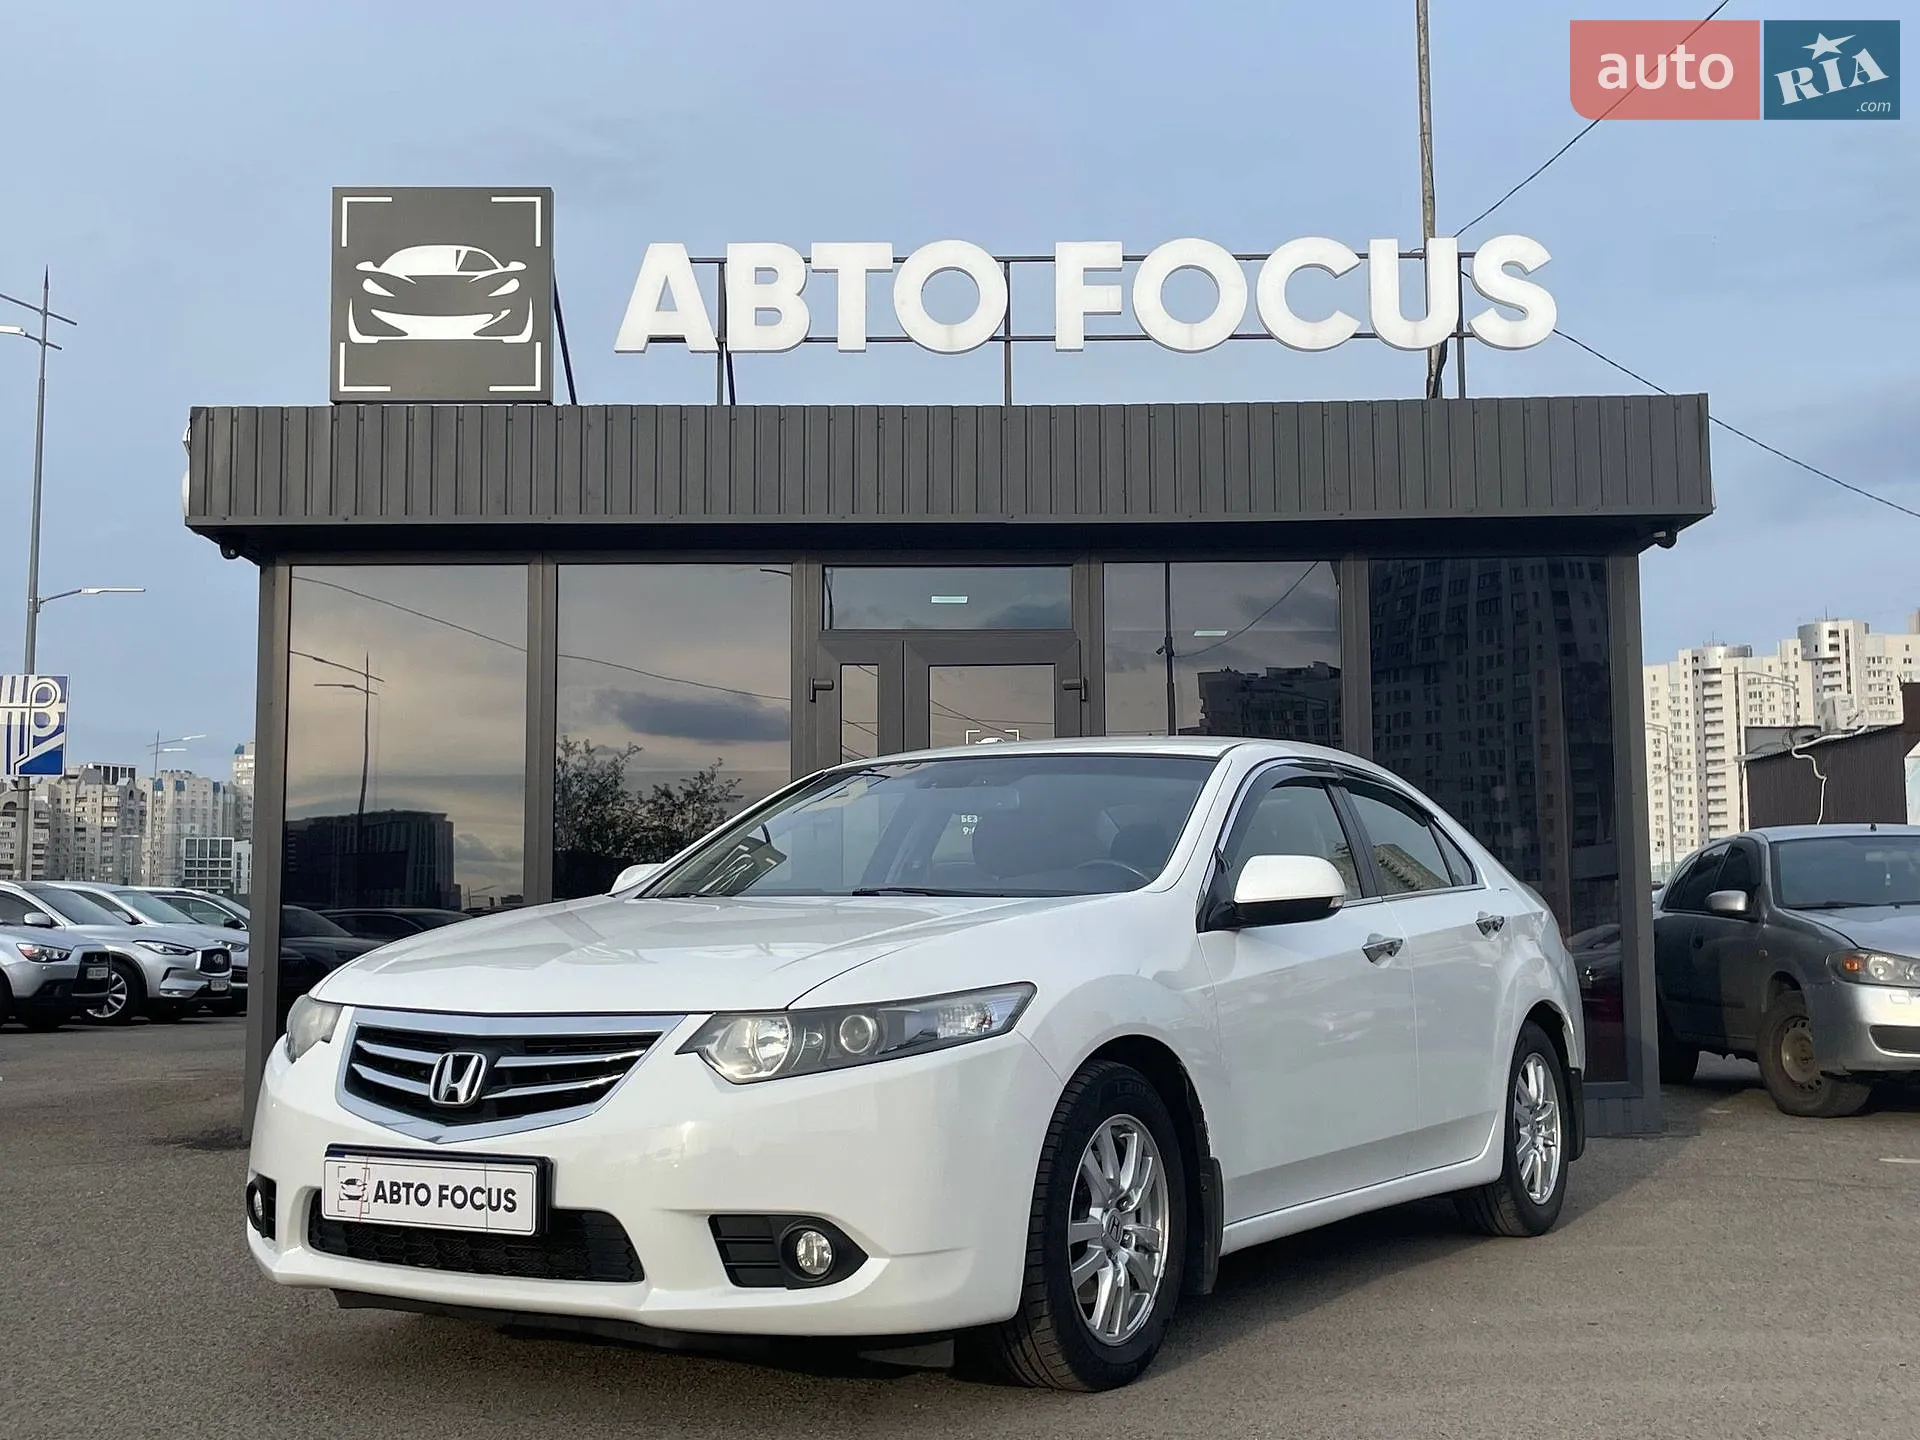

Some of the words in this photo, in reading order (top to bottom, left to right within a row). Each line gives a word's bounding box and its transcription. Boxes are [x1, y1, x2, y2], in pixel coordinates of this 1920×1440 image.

[614, 239, 1009, 354] АВТО
[1055, 235, 1558, 354] FOCUS
[373, 1180, 432, 1207] АВТО
[437, 1184, 518, 1213] FOCUS
